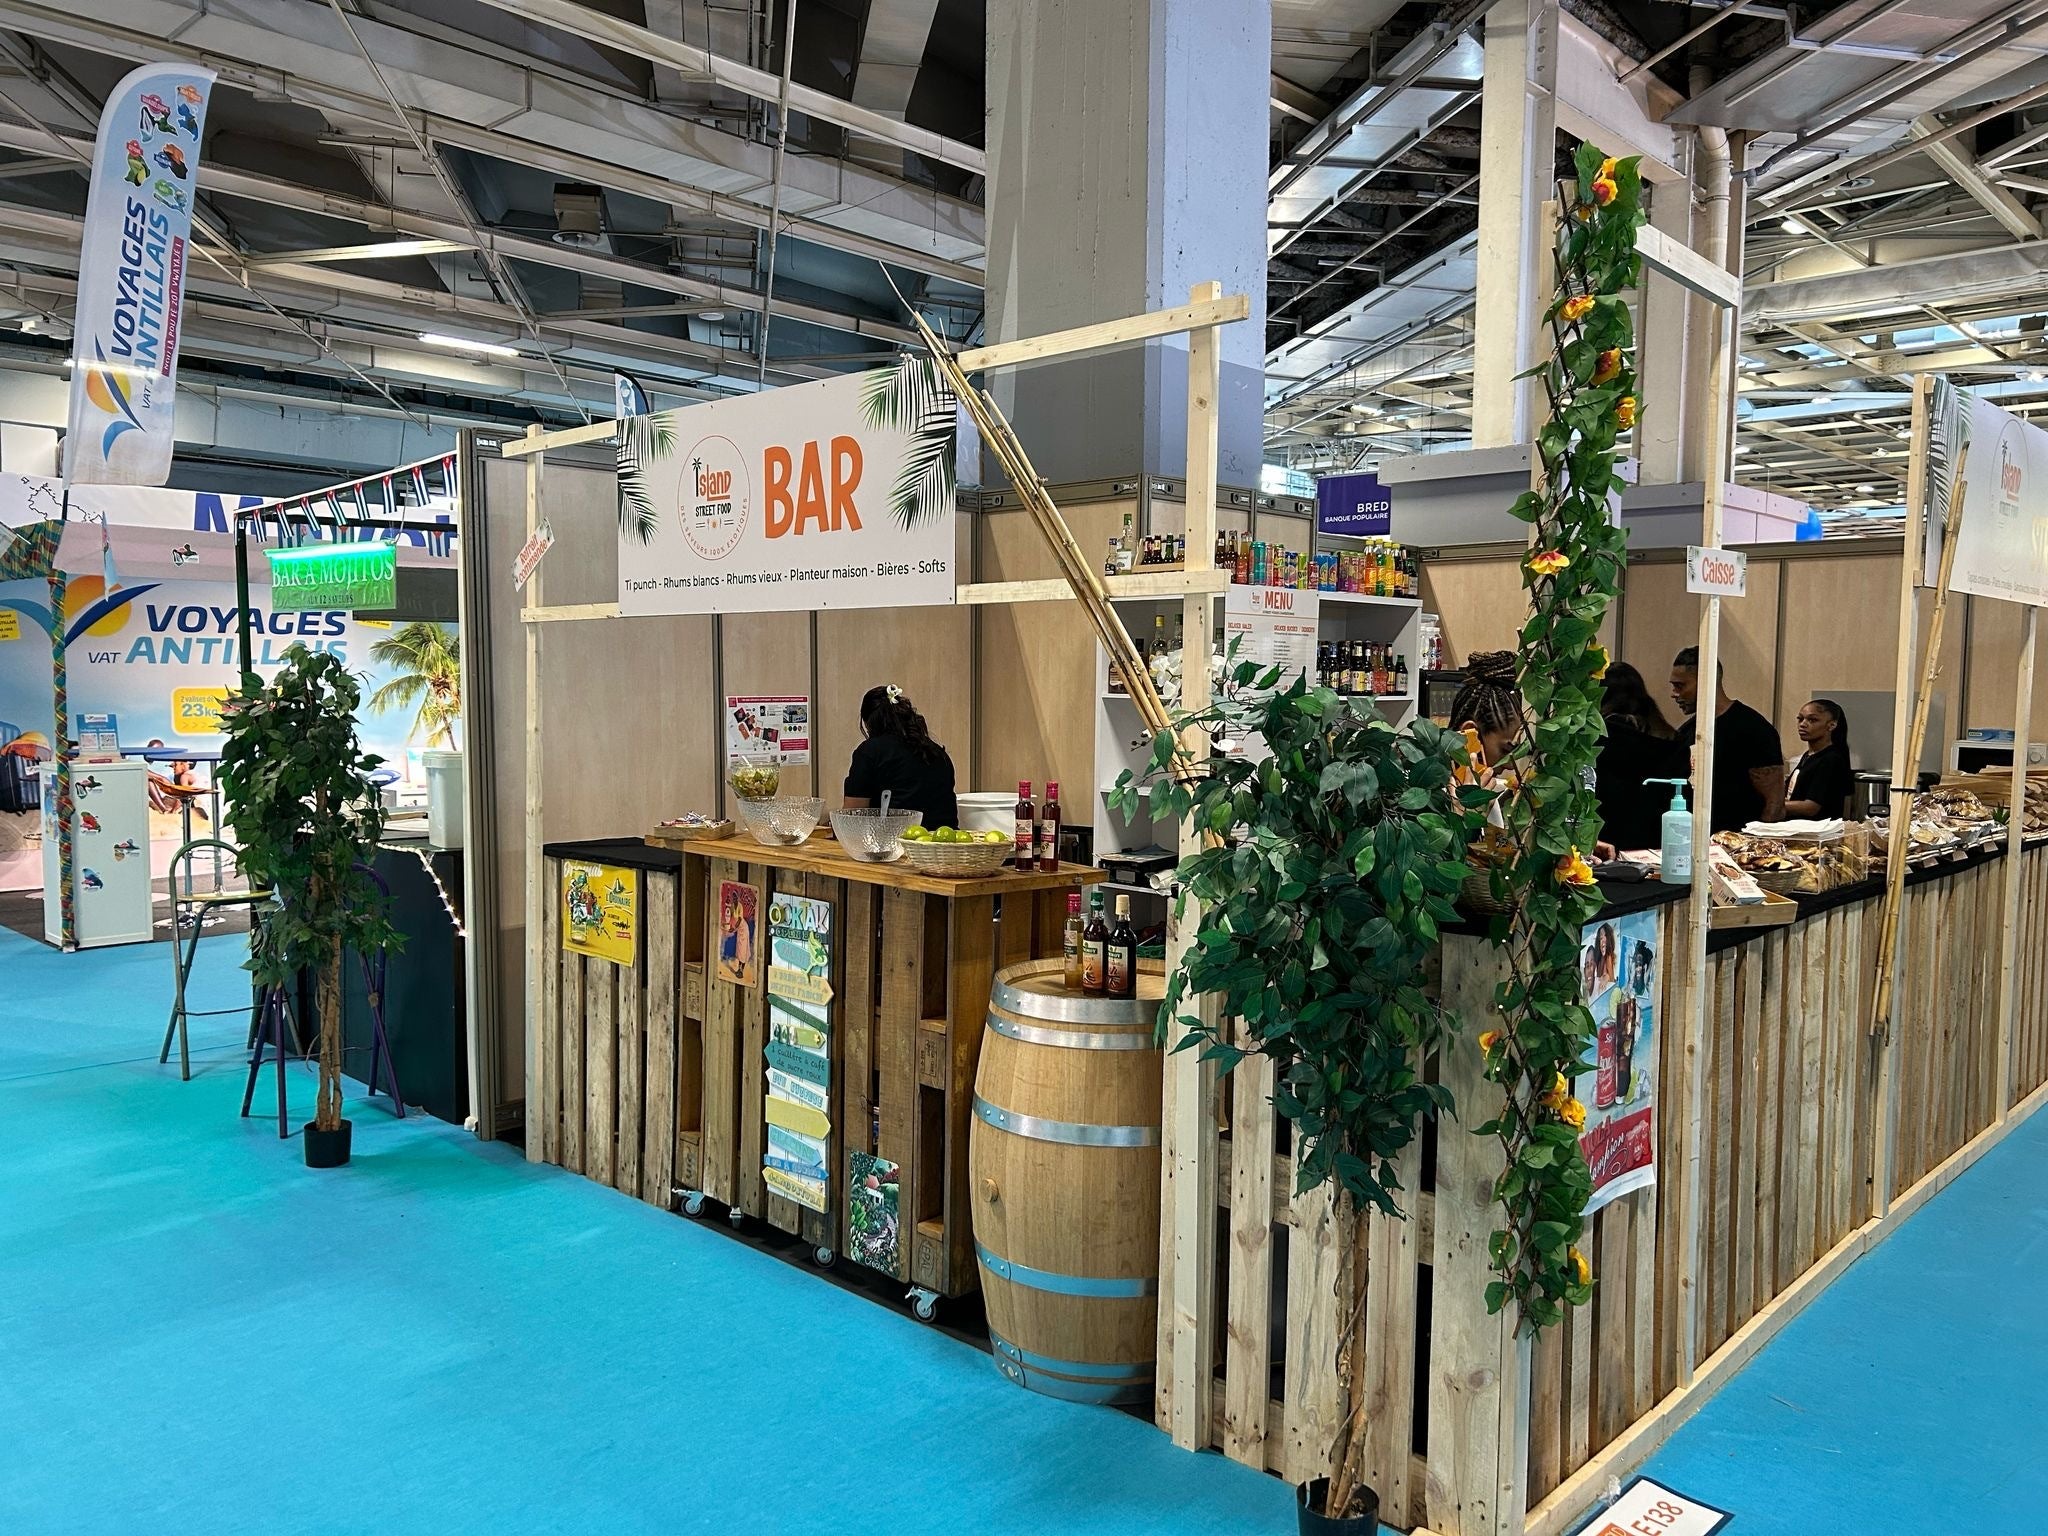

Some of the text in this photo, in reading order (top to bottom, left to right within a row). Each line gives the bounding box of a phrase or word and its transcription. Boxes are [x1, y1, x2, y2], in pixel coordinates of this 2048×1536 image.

[111, 196, 146, 356] VOYAGES
[133, 207, 169, 409] VAT ANTILLAIS
[764, 435, 864, 539] BAR
[695, 503, 732, 517] STREET FOOD
[1325, 512, 1388, 523] BANQUE POPULAIRE
[1357, 501, 1389, 513] BRED
[685, 526, 708, 555] SAVEURS
[709, 547, 726, 556] 100%
[726, 498, 748, 549] EXOTIQUES
[272, 562, 301, 588] BAR
[320, 553, 394, 590] MOJITOS
[518, 539, 548, 583] commande
[1702, 556, 1735, 585] Caisse
[625, 579, 632, 591] Ti
[633, 577, 657, 593] punch
[663, 576, 691, 589] Rhums
[693, 574, 720, 587] blancs
[727, 572, 756, 586] Rhums
[759, 571, 782, 583] vieux
[790, 566, 830, 581] Planteur
[832, 565, 868, 579] maison
[877, 562, 909, 577] Bières
[918, 558, 946, 574] Softs
[320, 595, 327, 604] 12
[1264, 591, 1294, 610] MENU
[88, 652, 121, 664] VAT
[186, 695, 206, 703] valises
[776, 1059, 822, 1081] de sucre roux
[810, 1060, 825, 1071] café
[1631, 1501, 1683, 1536] E138
